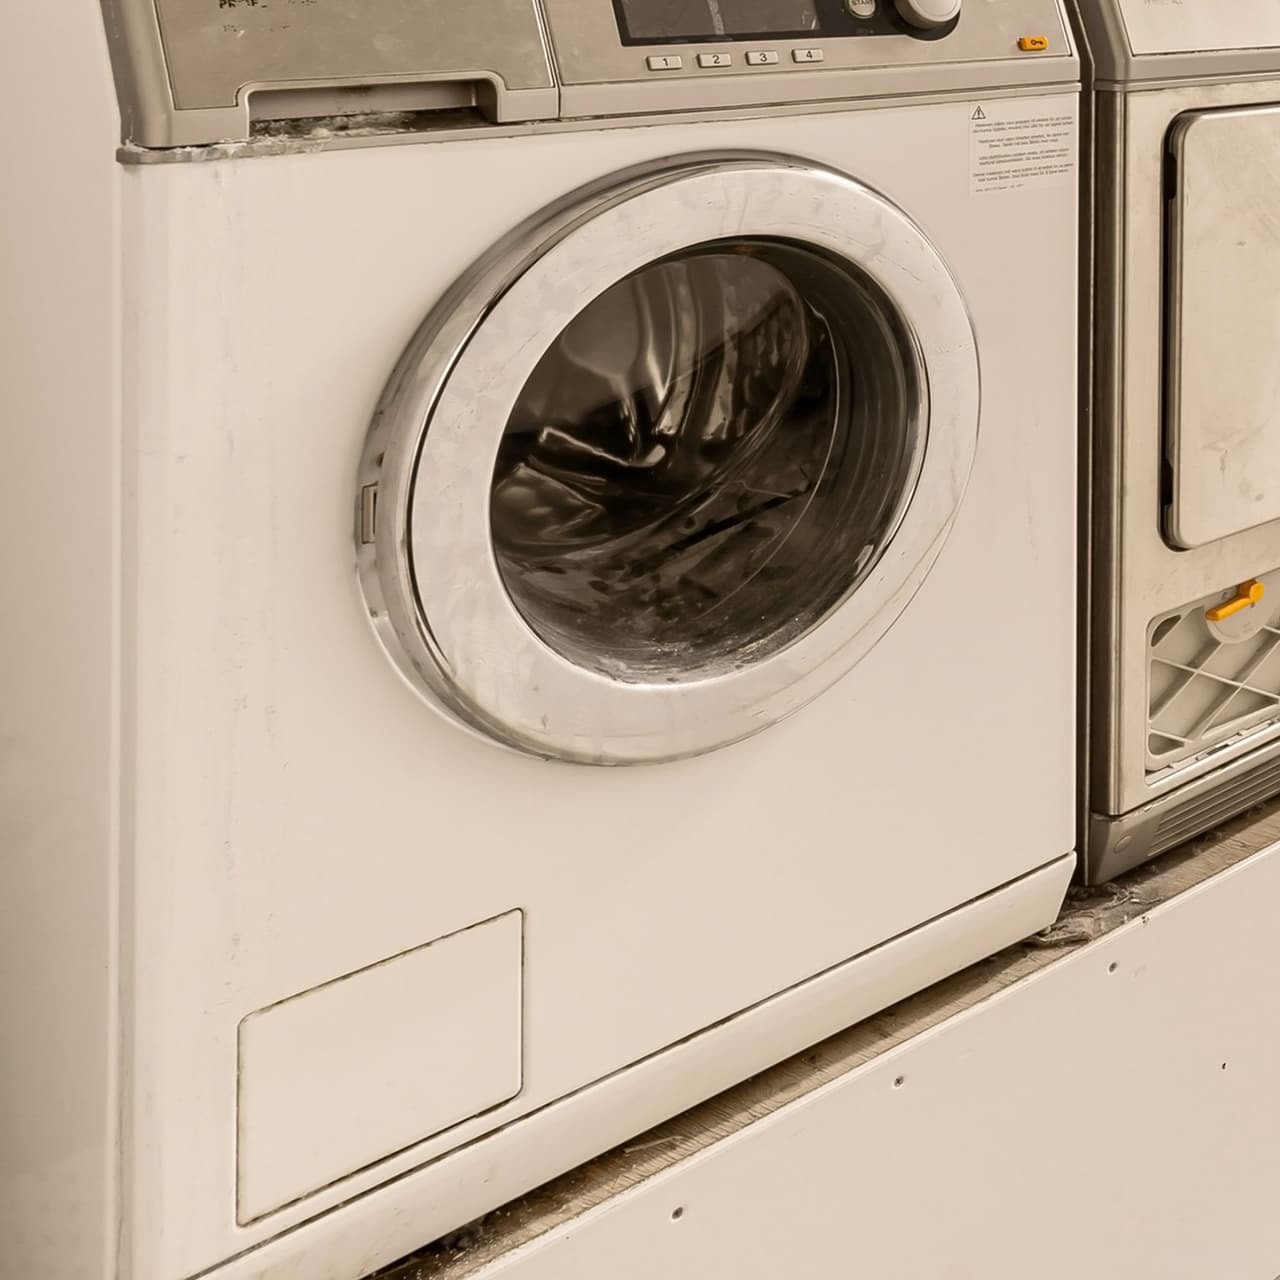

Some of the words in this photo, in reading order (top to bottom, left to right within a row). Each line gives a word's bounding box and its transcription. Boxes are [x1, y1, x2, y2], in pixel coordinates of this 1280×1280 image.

[662, 57, 669, 67] 1
[712, 54, 721, 64] 2
[759, 52, 768, 62] 3
[805, 50, 813, 59] 4
